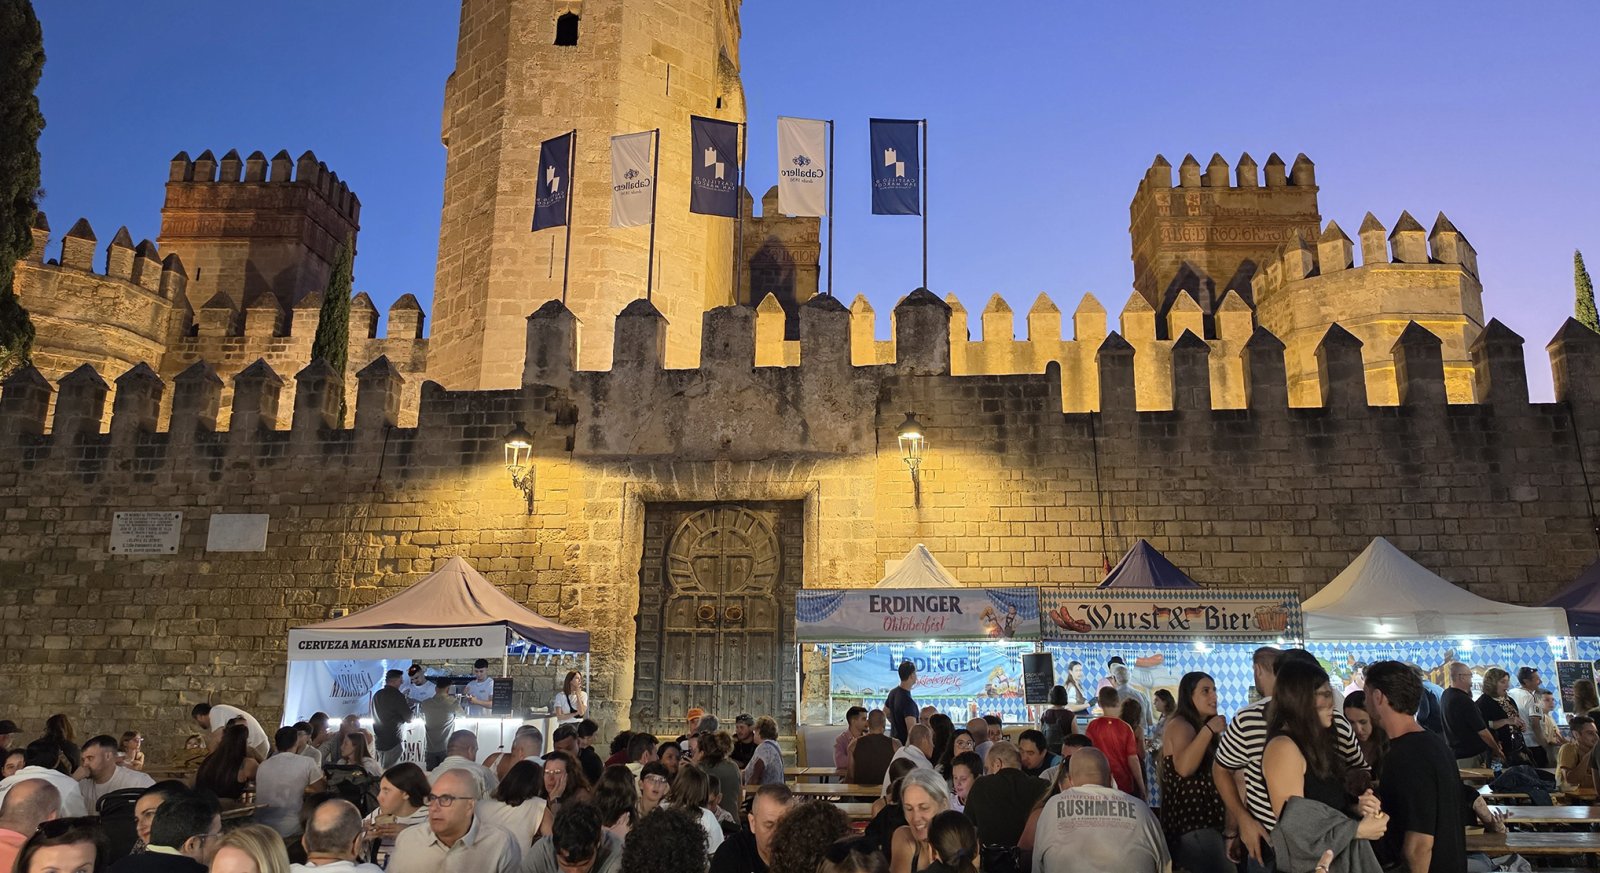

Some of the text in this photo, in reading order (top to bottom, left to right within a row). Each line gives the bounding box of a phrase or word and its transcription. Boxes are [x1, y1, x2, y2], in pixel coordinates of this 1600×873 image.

[869, 594, 964, 616] ERDINGER
[883, 615, 949, 634] Oktoberfest
[1078, 604, 1251, 630] Wurst & Bier
[298, 636, 483, 650] CERVEZA MARISMEÑA EL PUERTO
[889, 654, 983, 673] EDINGER
[1057, 799, 1136, 819] RUSHMERE
